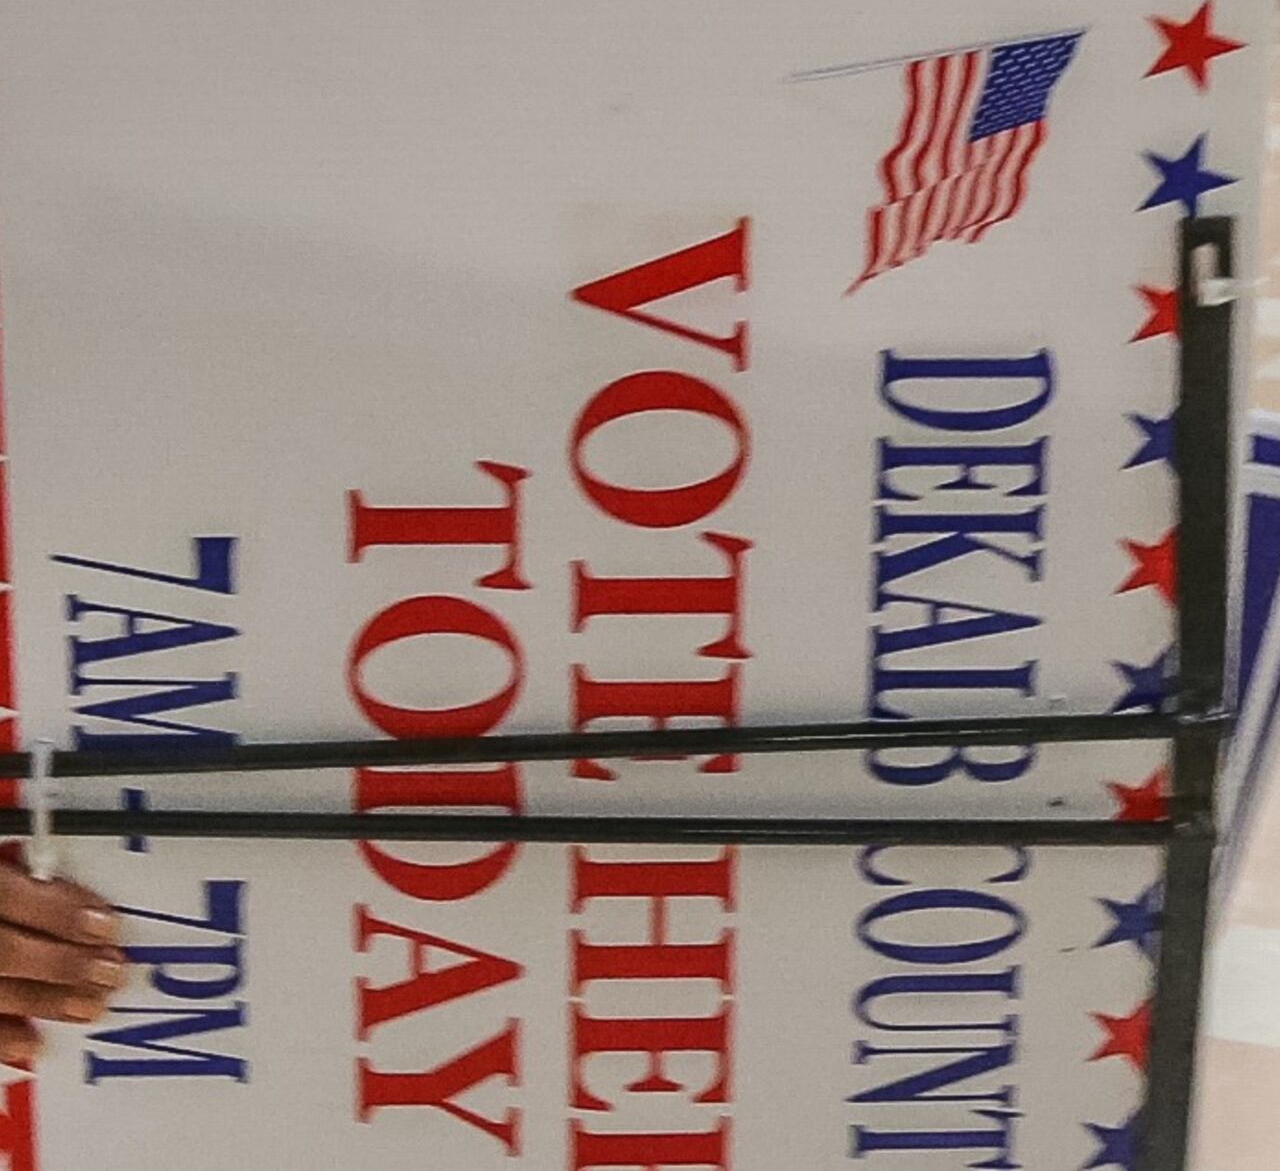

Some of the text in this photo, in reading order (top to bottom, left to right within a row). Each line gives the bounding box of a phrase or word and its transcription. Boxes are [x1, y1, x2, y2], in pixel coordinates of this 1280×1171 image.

[48, 535, 241, 754] 7AM
[568, 214, 754, 781] VOTE
[865, 347, 1058, 786] DEKALB
[84, 880, 250, 1085] 7PM
[345, 459, 533, 1157] TODAY
